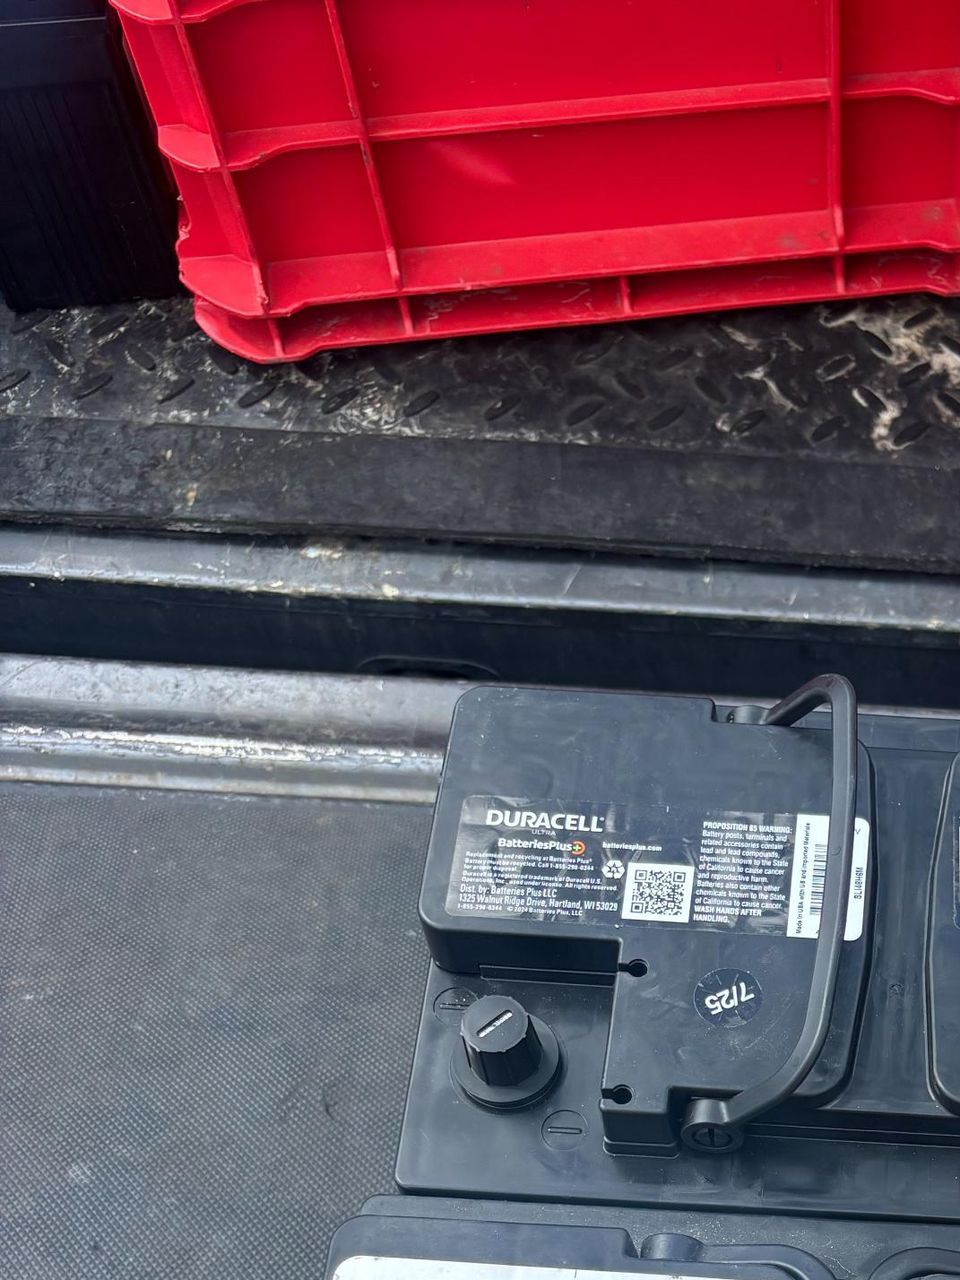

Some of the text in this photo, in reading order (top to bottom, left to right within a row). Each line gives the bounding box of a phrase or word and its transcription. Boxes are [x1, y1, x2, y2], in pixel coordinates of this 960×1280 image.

[486, 810, 603, 832] DURACELL
[703, 821, 747, 831] PROPOSITION
[759, 824, 792, 834] WARNING:
[602, 842, 662, 852] batteriesplus.com
[460, 884, 557, 898] Dist. by: Batteries Plus LLC
[460, 893, 618, 911] 1325 Walnut Ridge Drive, Hartland, WI 53029
[705, 982, 754, 1015] 7/25
